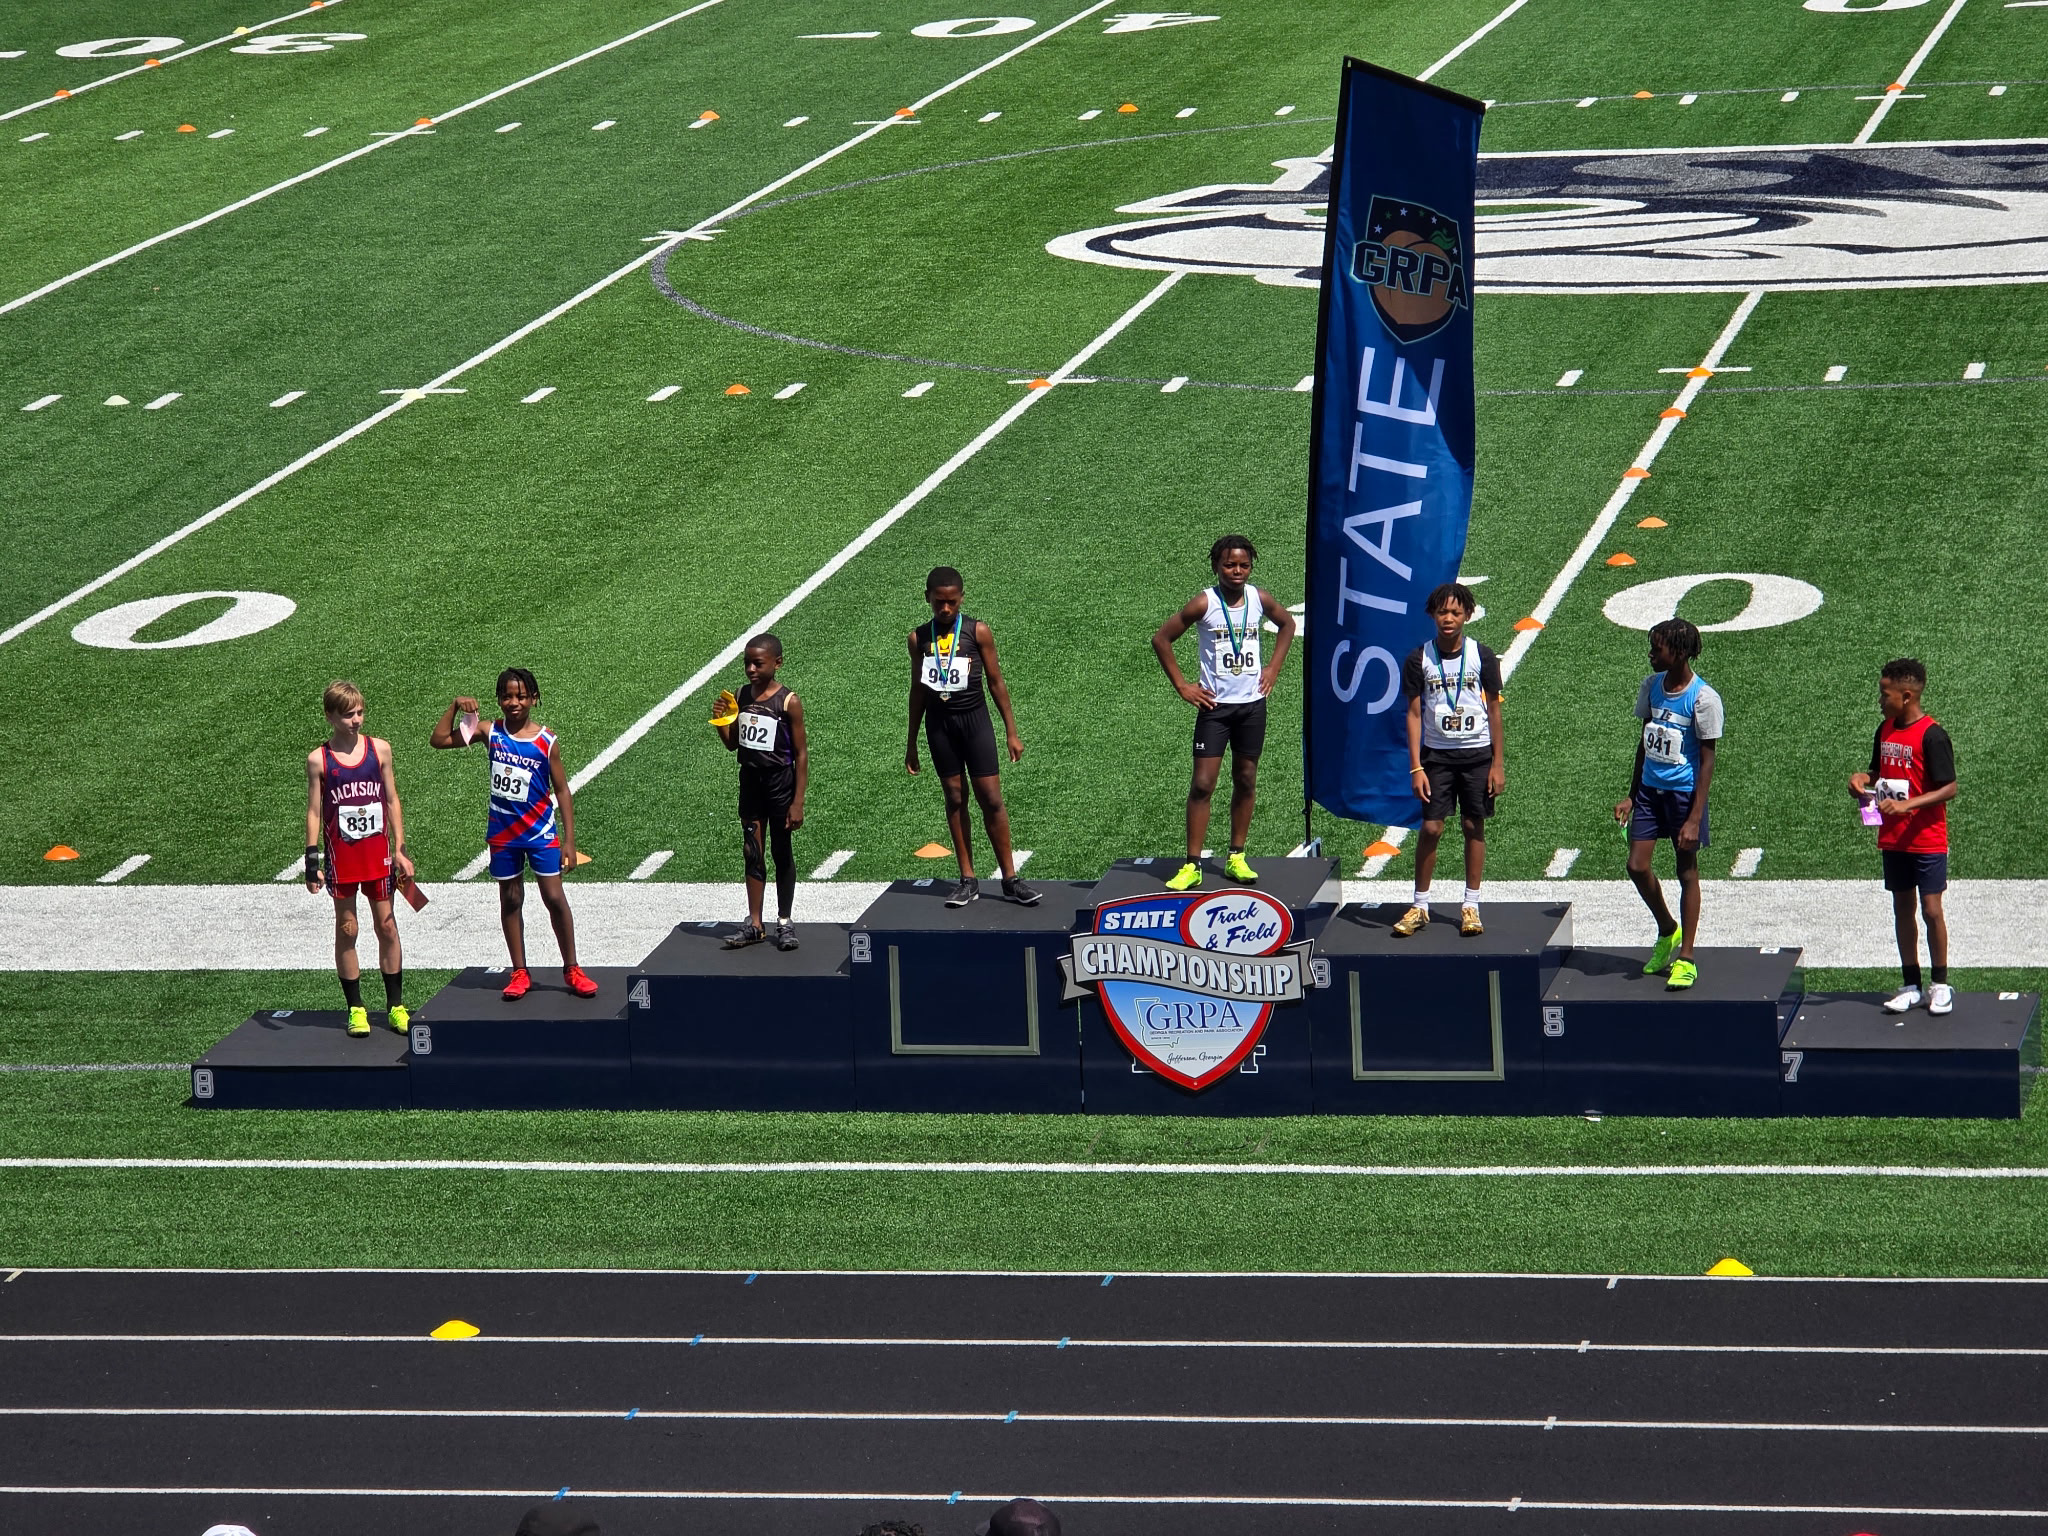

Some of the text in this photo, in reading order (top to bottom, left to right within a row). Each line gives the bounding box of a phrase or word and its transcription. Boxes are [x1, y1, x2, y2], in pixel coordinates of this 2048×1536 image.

[1350, 240, 1469, 311] GRPA
[1330, 346, 1446, 716] STATE
[1222, 651, 1254, 669] 606
[928, 668, 960, 685] 98
[740, 724, 768, 744] 302
[1646, 732, 1672, 756] 941
[331, 782, 381, 804] JACKSON
[493, 774, 521, 795] 993
[346, 815, 375, 832] 831
[1104, 901, 1259, 930] STATE Track
[851, 932, 872, 963] 2
[1205, 922, 1278, 950] & Field
[1081, 943, 1293, 996] CHAMPIONSHIP
[1311, 958, 1331, 989] 3
[629, 979, 651, 1009] 4
[1145, 1001, 1243, 1031] GRPA
[1543, 1006, 1565, 1037] 5
[411, 1025, 432, 1055] 6
[1782, 1052, 1804, 1083] 7
[194, 1068, 214, 1099] 8
